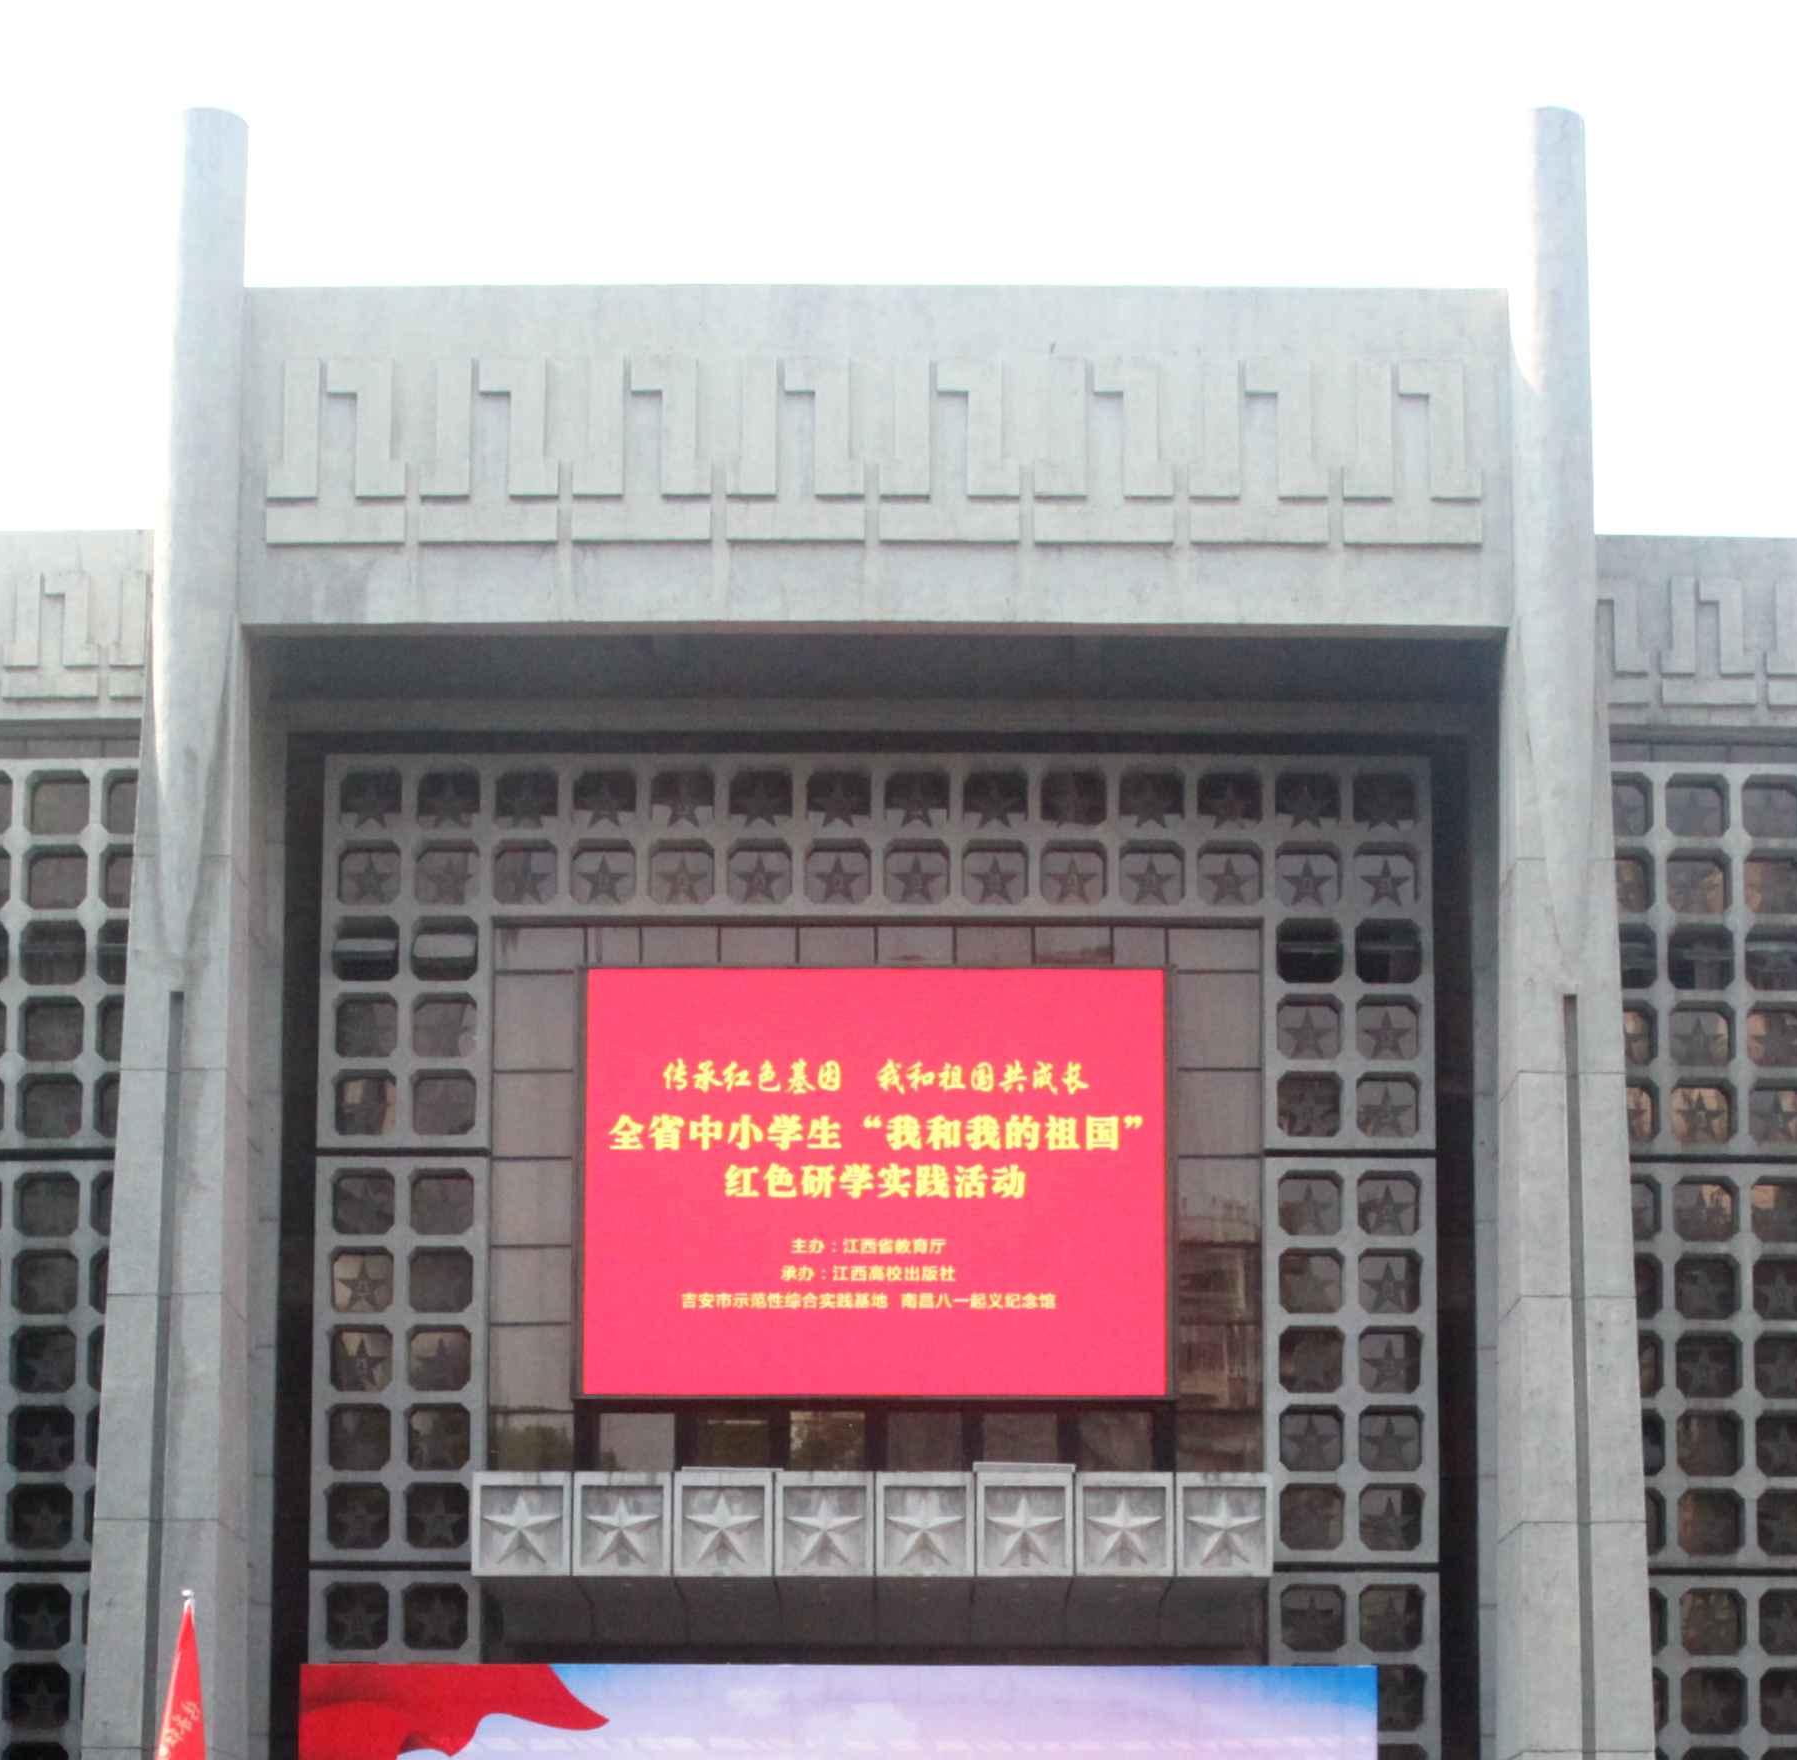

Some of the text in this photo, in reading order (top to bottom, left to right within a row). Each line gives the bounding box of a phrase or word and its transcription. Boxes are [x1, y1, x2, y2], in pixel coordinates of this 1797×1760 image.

[662, 1057, 1090, 1095] 传承红色基因 我和祖国共成长
[723, 1163, 1027, 1199] 红色研学实践活动
